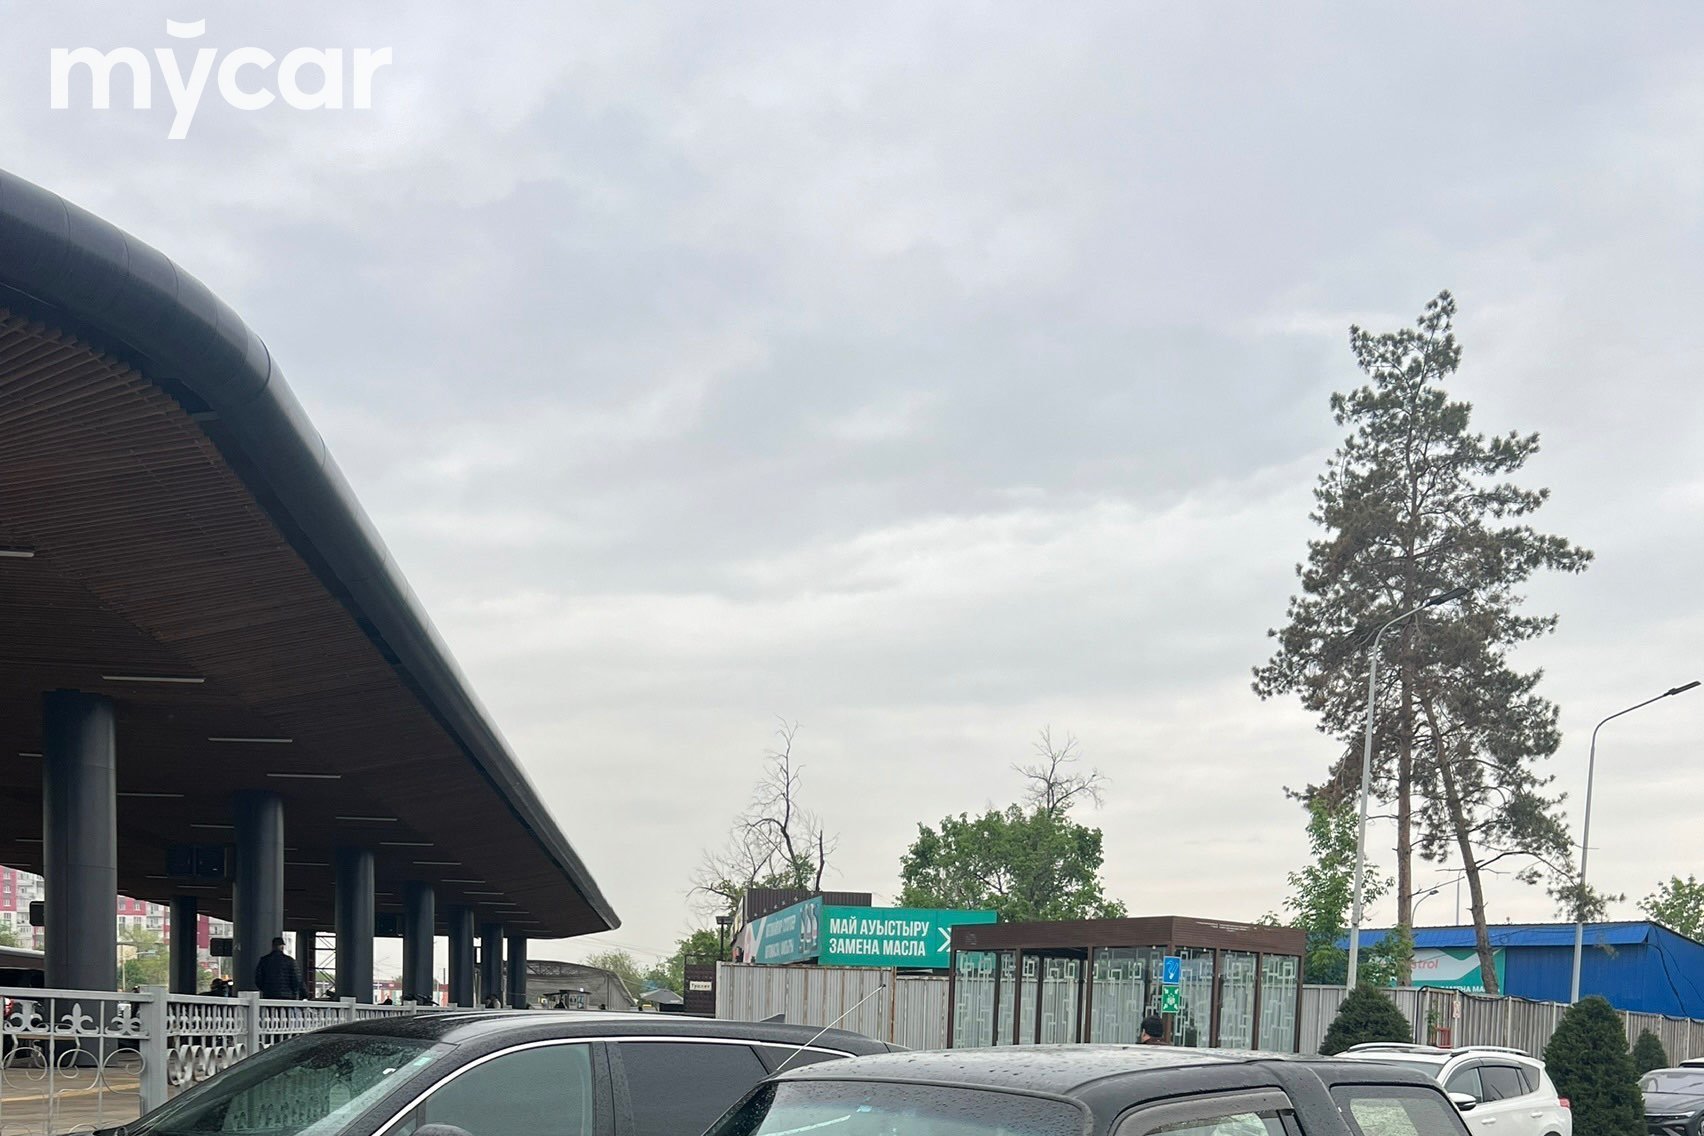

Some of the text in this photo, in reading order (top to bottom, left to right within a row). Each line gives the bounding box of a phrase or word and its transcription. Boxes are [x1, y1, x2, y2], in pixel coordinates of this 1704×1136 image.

[829, 915, 930, 937] МАЙ АУЫСТЫРУ
[829, 938, 926, 957] ЗАМЕНА МАСЛА
